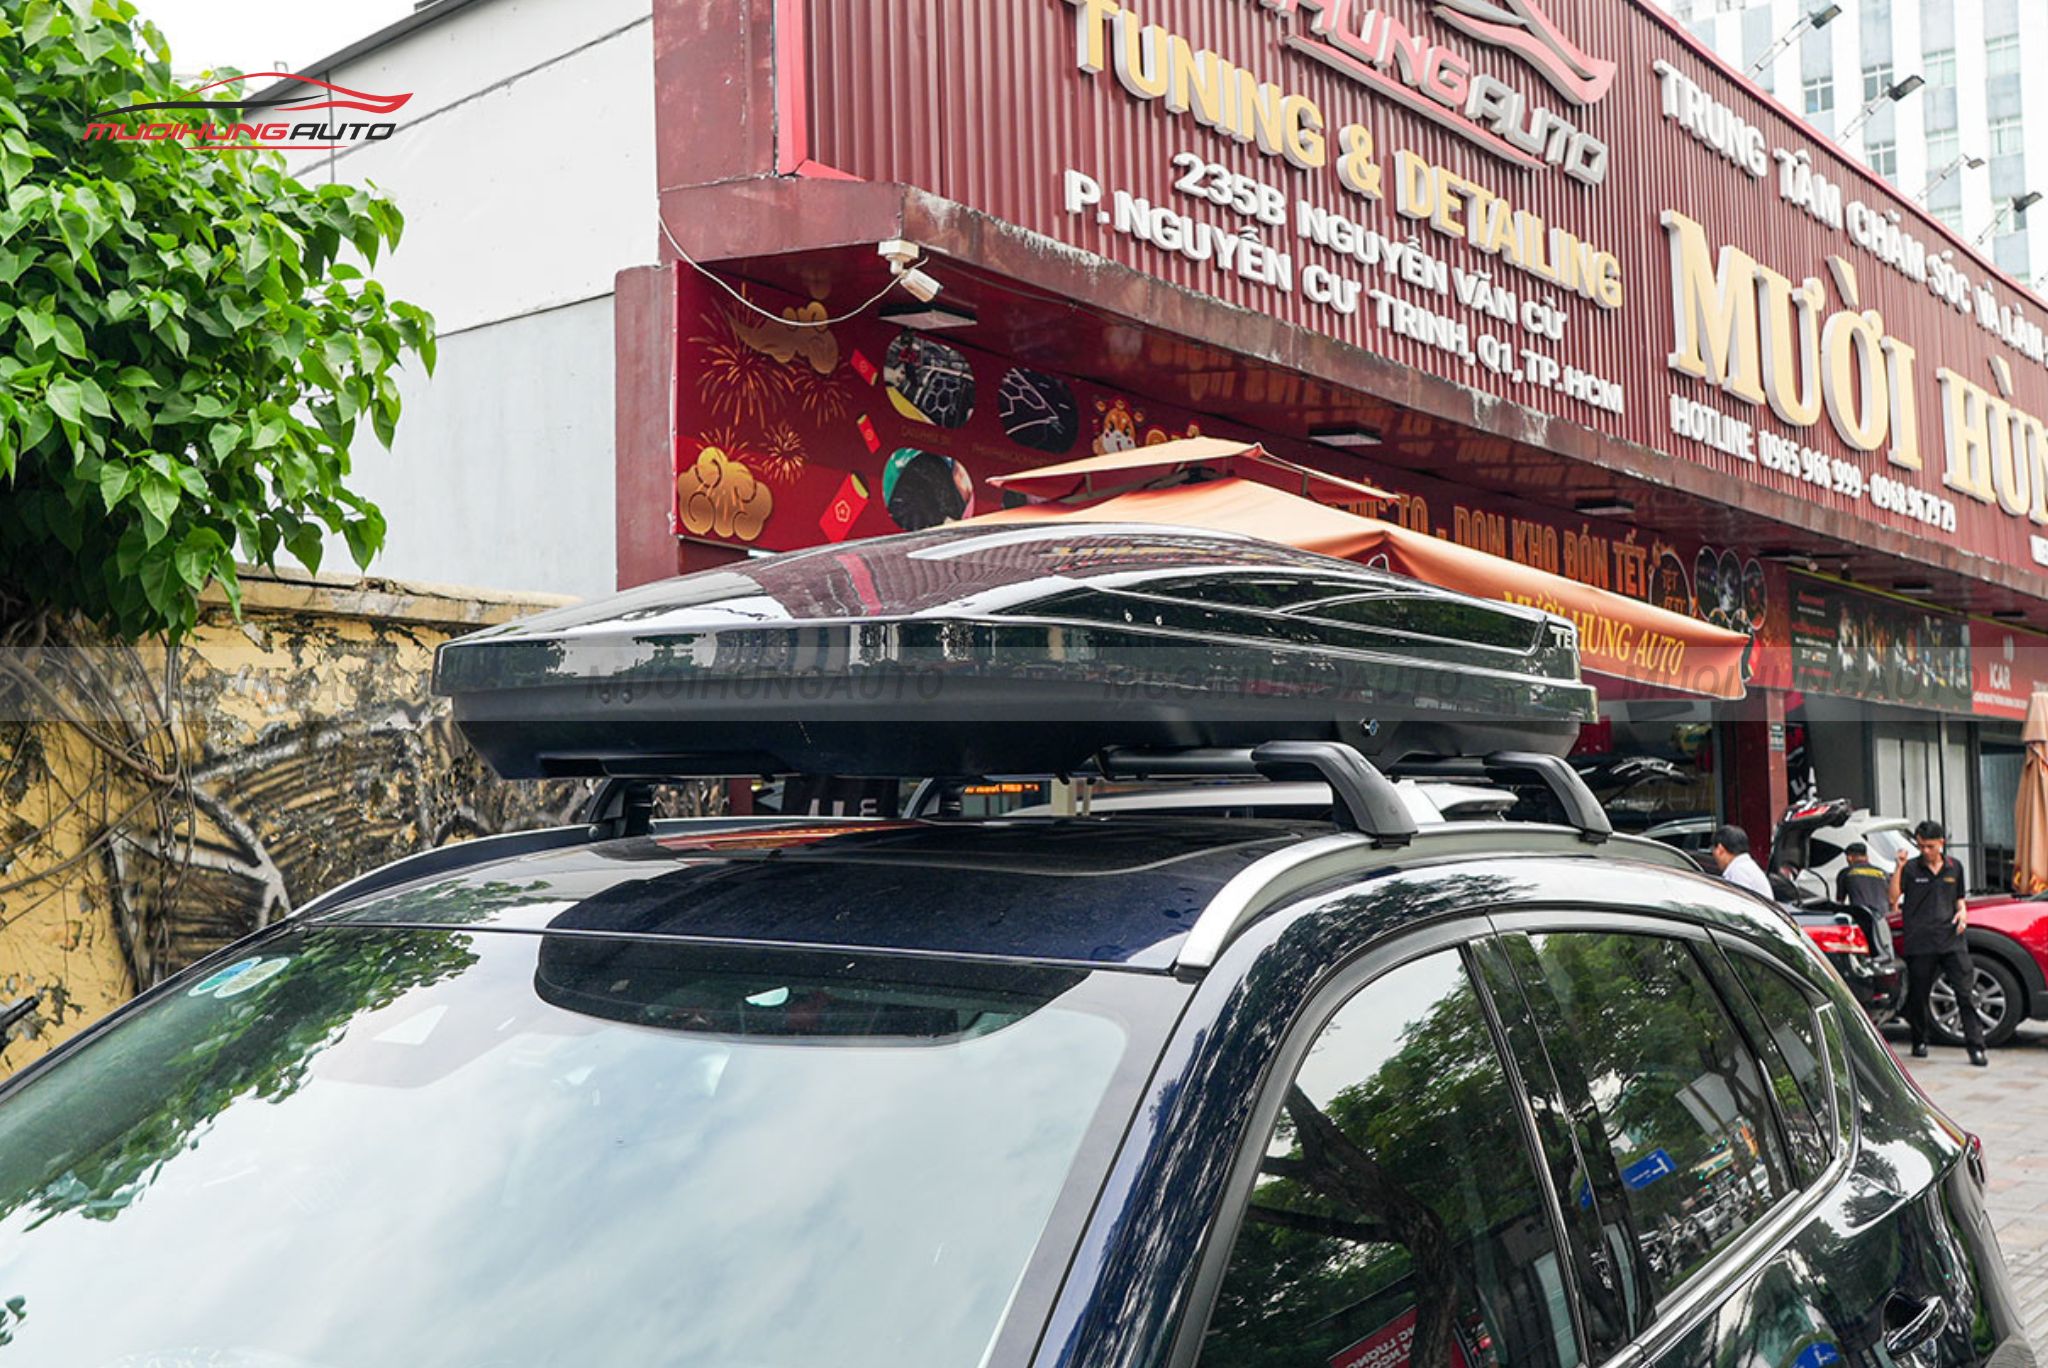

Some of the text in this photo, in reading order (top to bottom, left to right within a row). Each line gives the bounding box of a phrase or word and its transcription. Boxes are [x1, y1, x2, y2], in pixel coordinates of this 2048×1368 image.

[1063, 0, 1622, 310] TUNING & DETAILING
[1173, 151, 1568, 341] 235B NGUYỄN VĂN CỪ
[1653, 58, 1768, 178] TRUNG
[1774, 147, 1843, 231] TÂM
[1846, 200, 1926, 283] CHĂM
[1926, 250, 1972, 314] SÓC
[1660, 208, 1923, 471] MƯỜI
[1670, 393, 1757, 464] HOTLINE
[1512, 518, 1559, 575] KHO
[1613, 528, 1647, 597] TẾT
[1572, 604, 1633, 662] HÙNG
[1634, 629, 1685, 676] AUTO
